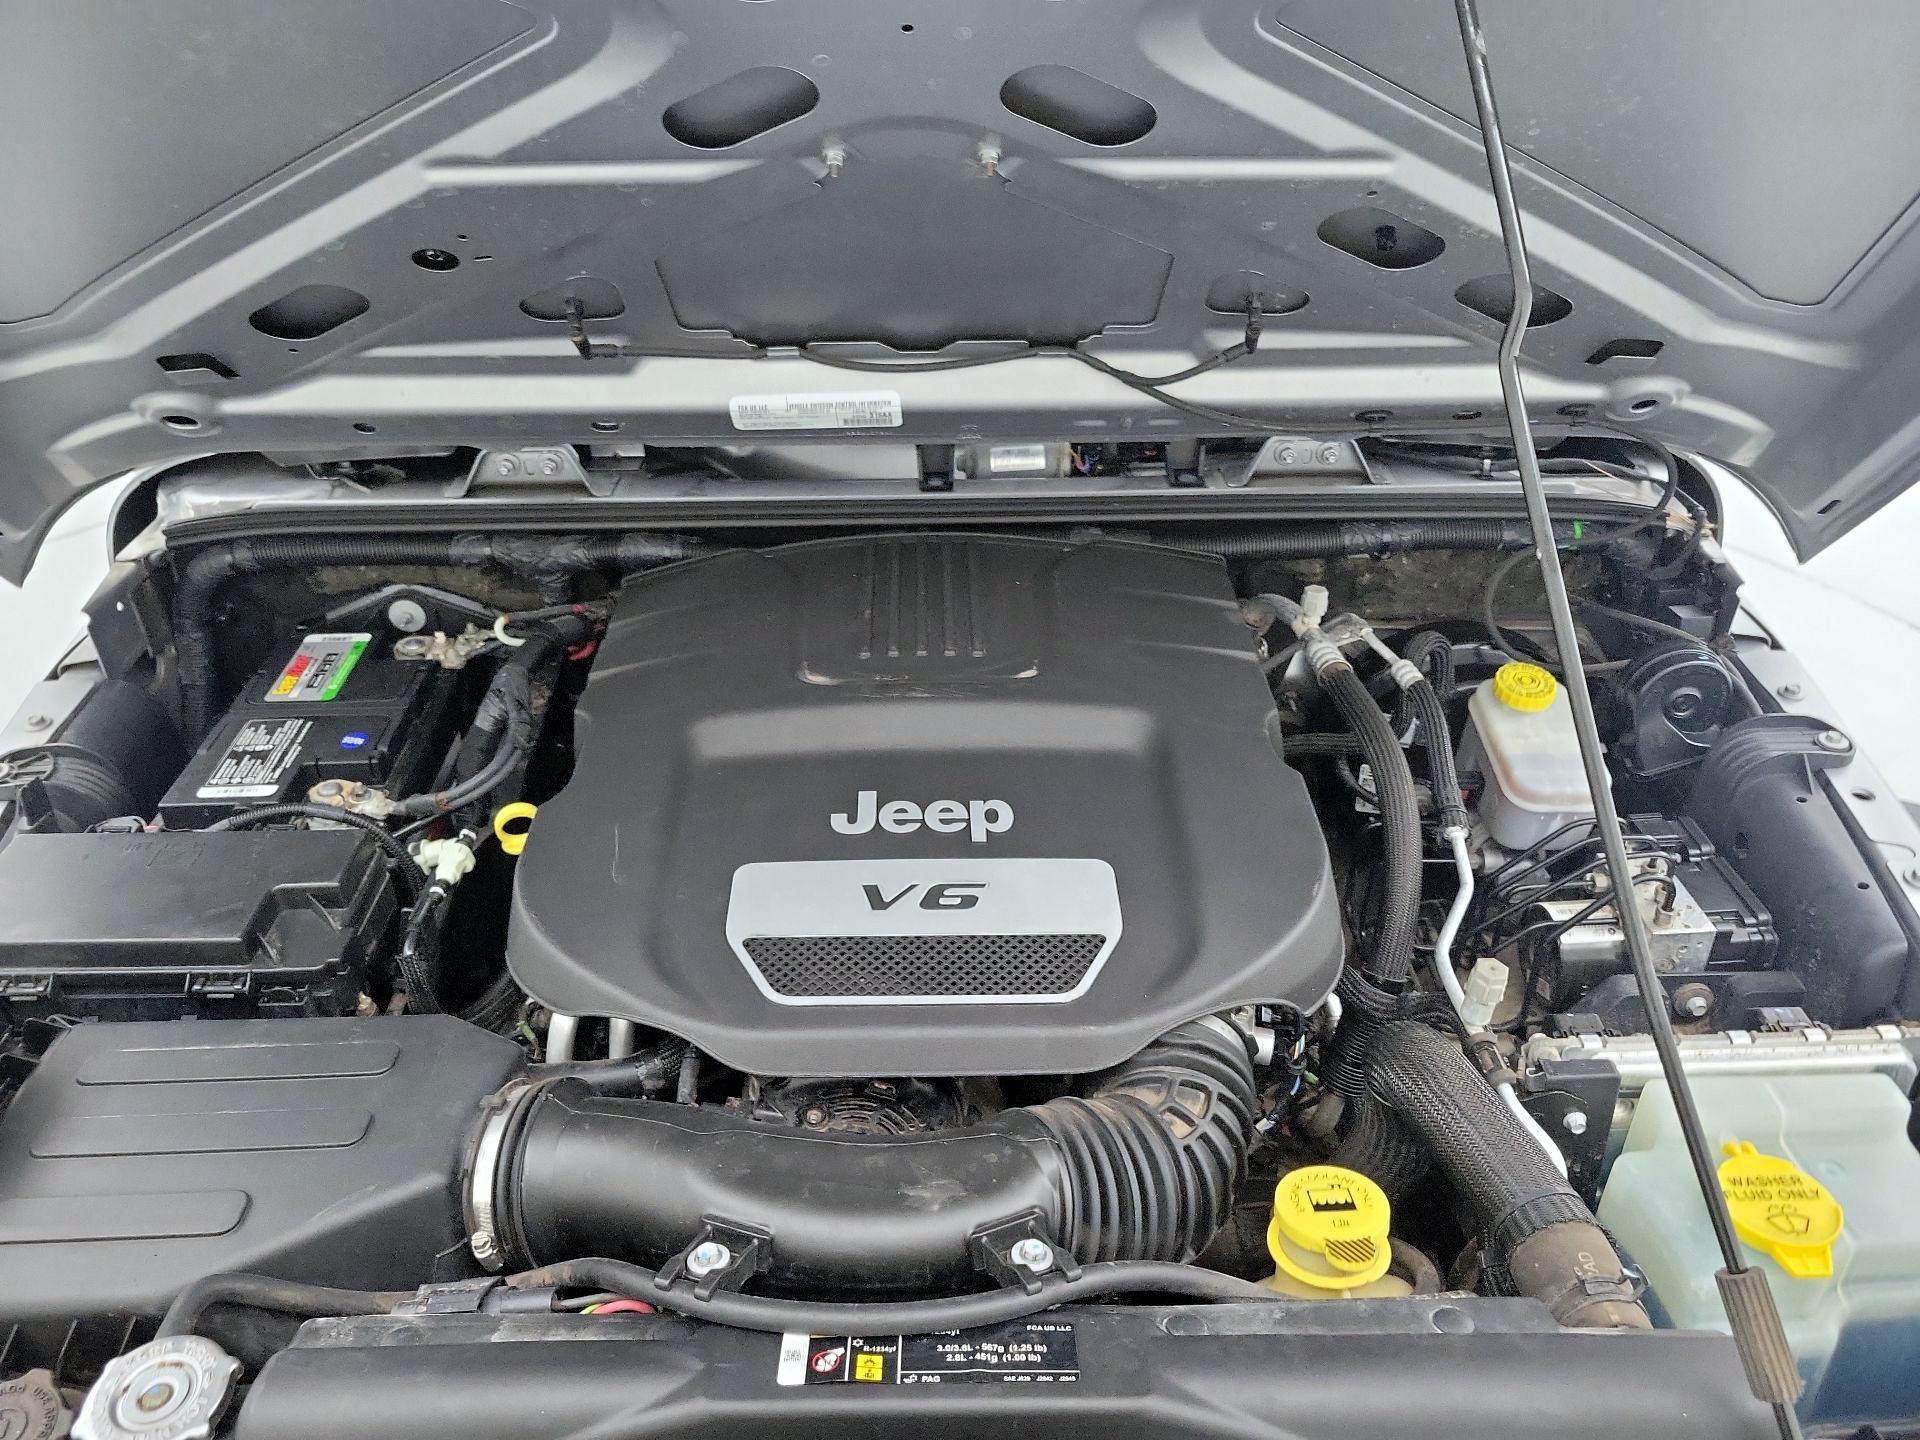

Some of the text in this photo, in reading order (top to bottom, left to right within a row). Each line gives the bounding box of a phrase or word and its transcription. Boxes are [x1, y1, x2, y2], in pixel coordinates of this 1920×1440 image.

[830, 790, 1015, 843] Jeep
[861, 882, 987, 911] V6
[1727, 1175, 1804, 1188] WASHER
[1777, 1187, 1821, 1201] ONLY
[981, 1342, 1005, 1353] 567g
[921, 1375, 941, 1383] PAG
